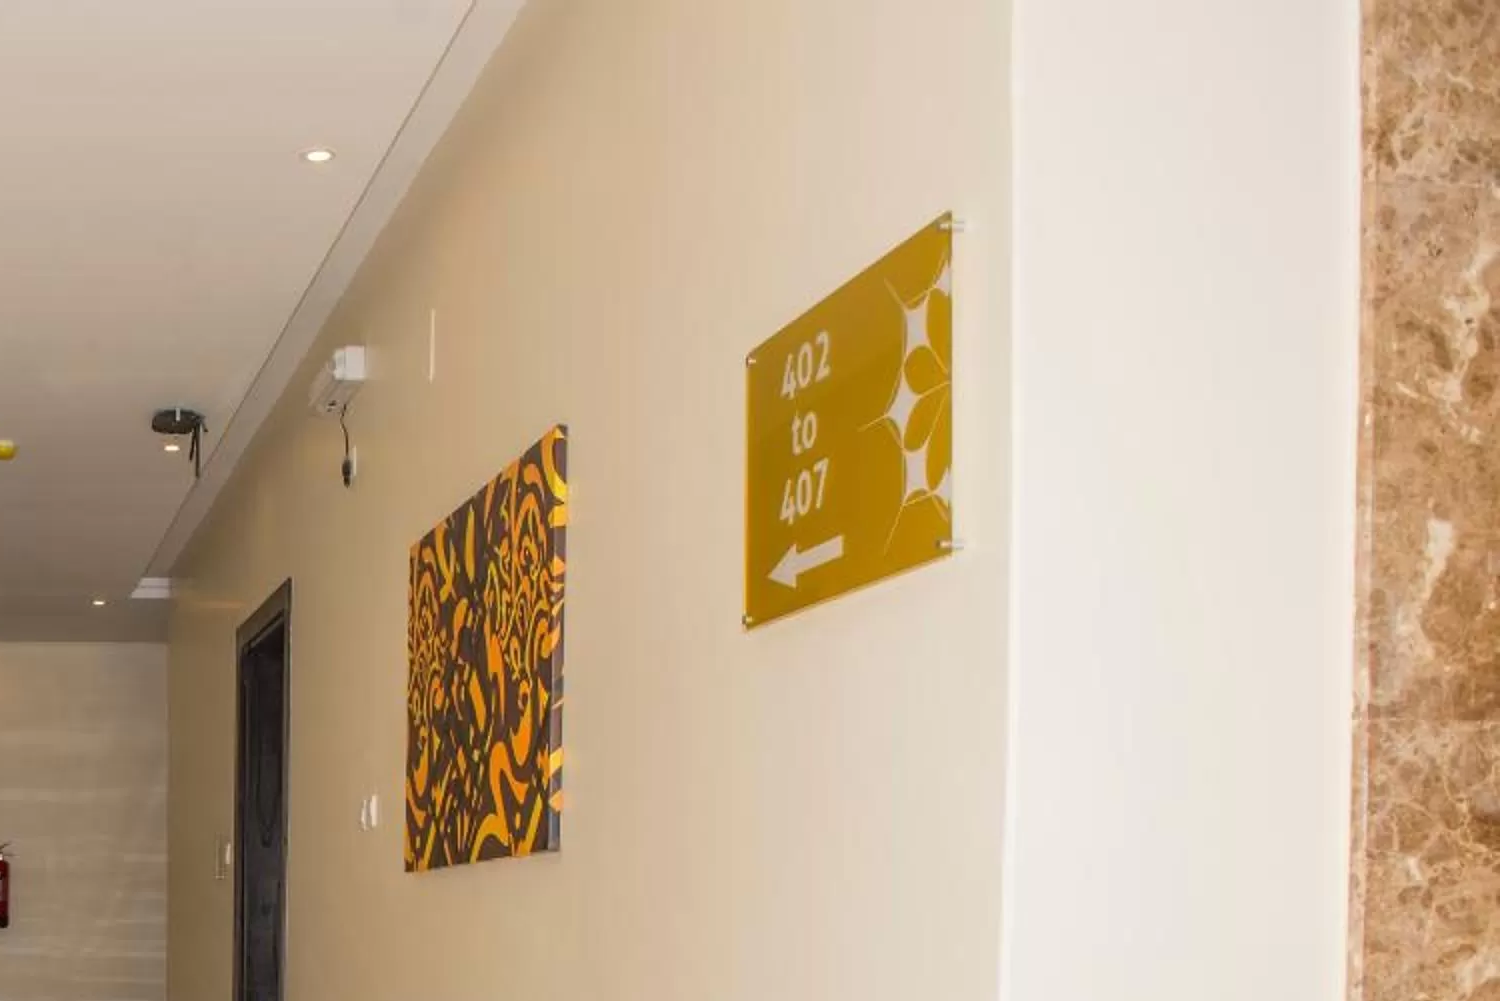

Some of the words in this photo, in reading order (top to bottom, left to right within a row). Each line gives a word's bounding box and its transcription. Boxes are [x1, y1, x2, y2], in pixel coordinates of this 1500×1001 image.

[781, 330, 831, 400] 402
[791, 411, 817, 455] to
[779, 458, 829, 525] 407
